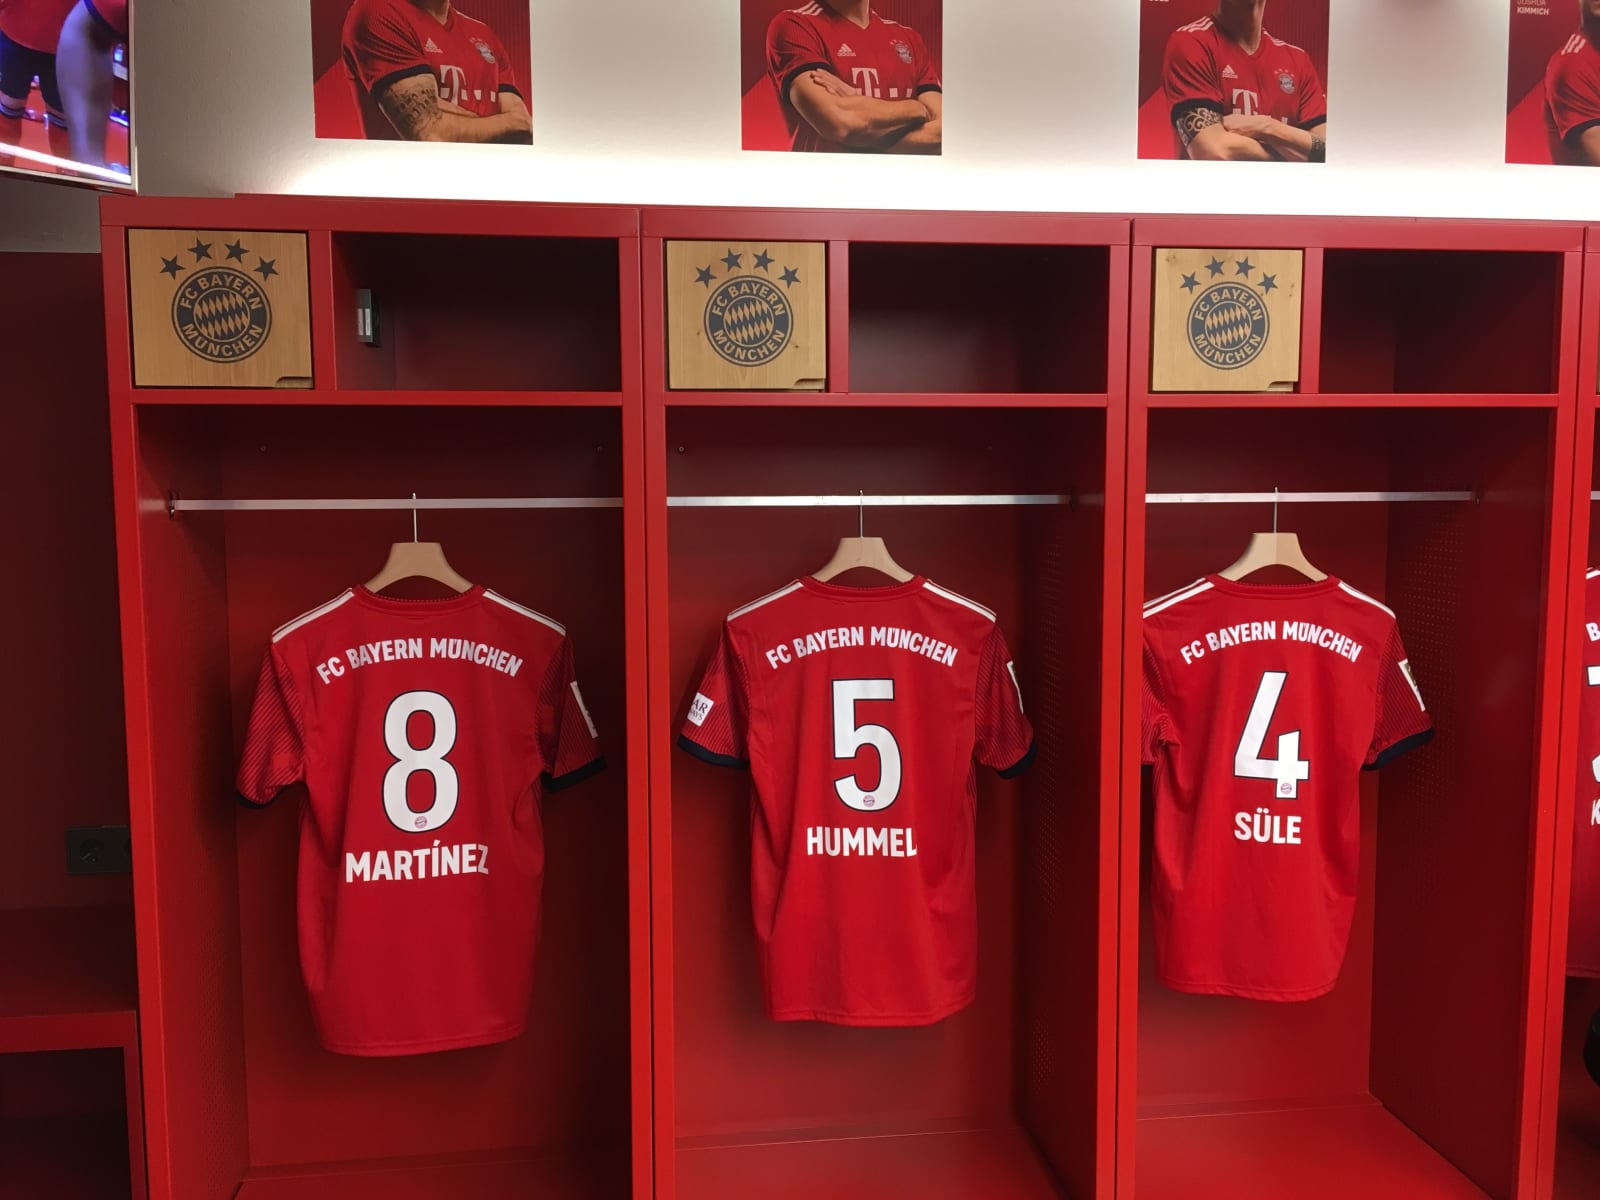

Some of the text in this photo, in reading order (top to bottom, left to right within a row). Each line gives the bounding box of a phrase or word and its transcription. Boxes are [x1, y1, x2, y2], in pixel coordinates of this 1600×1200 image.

[1517, 6, 1550, 15] KIMMICH
[180, 274, 262, 310] FC BAYERN
[711, 282, 786, 316] FC BAYERN
[1194, 288, 1263, 321] FC BAYERN
[316, 637, 523, 685] FC BAYERN MÜNCHEN
[765, 626, 959, 670] FC BAYERN MÜNCHEN
[1180, 620, 1363, 665] FC BAYERN MÜNCHEN
[831, 678, 903, 812] 5
[1233, 670, 1310, 800] 4
[382, 689, 459, 833] 8
[806, 826, 918, 858] HUMMEL
[1234, 808, 1303, 846] SÜLE
[345, 840, 490, 884] MARTÍNEZ
